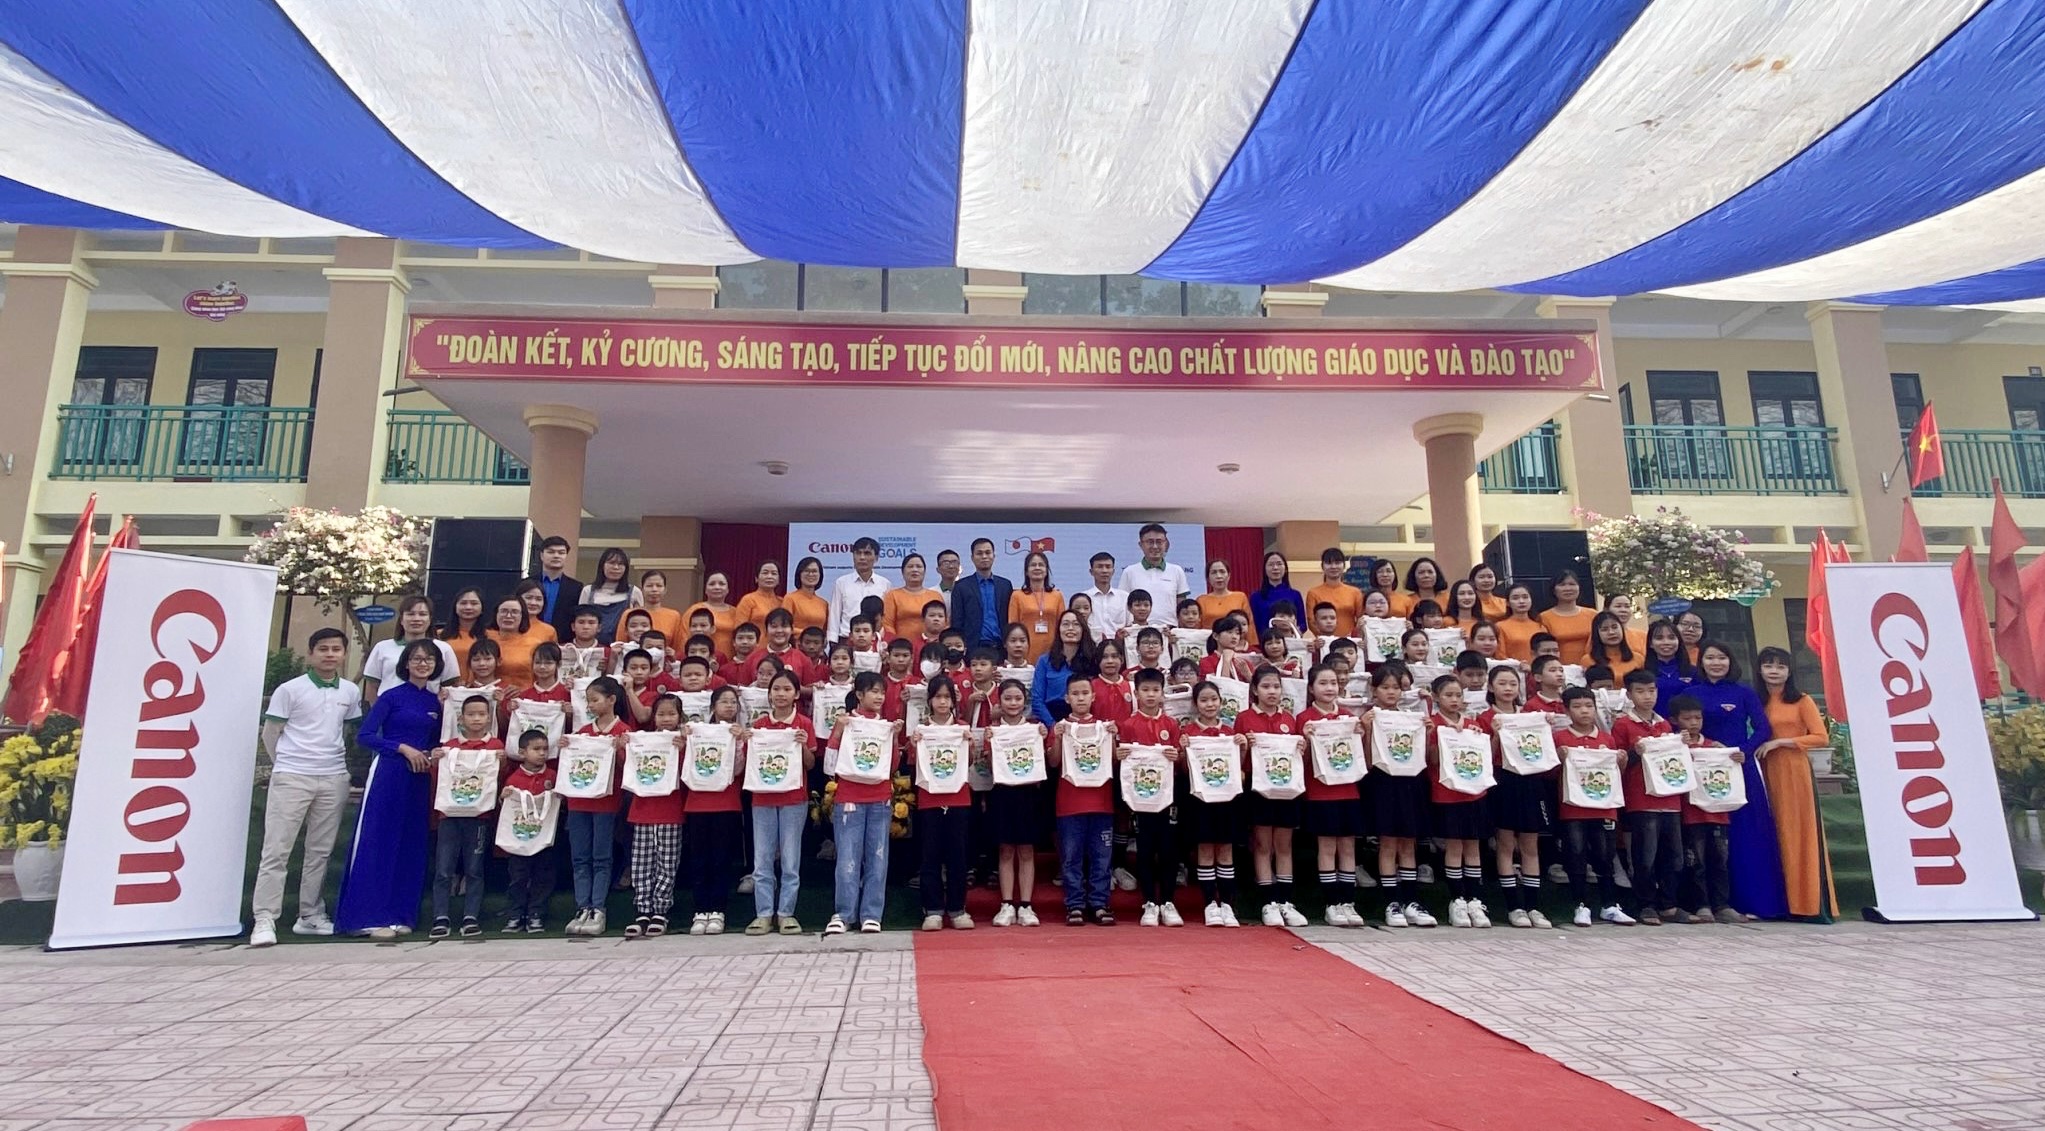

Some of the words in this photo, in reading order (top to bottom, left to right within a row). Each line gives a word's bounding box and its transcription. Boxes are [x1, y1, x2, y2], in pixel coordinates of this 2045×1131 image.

[436, 329, 518, 365] "ĐOÀN
[525, 327, 573, 369] KẾT,
[581, 328, 613, 366] KỶ
[620, 336, 710, 373] CƯƠNG,
[717, 335, 783, 370] SÁNG
[790, 342, 840, 377] TẠO,
[847, 335, 898, 371] TIẾP
[904, 344, 948, 378] TỤC
[954, 334, 993, 373] ĐỔI
[1000, 339, 1051, 377] MỚI,
[1057, 341, 1122, 374] NÂNG
[1129, 346, 1173, 375] CAO
[1180, 338, 1237, 375] CHẤT
[1243, 344, 1318, 381] LƯỢNG
[1324, 343, 1378, 376] GIÁO
[1384, 347, 1429, 381] DỤC
[1435, 343, 1465, 376] VÀ
[1471, 343, 1516, 376] ĐÀO
[1521, 348, 1576, 382] TẠO"
[113, 588, 227, 905] Canon
[1871, 592, 1967, 886] Canon
